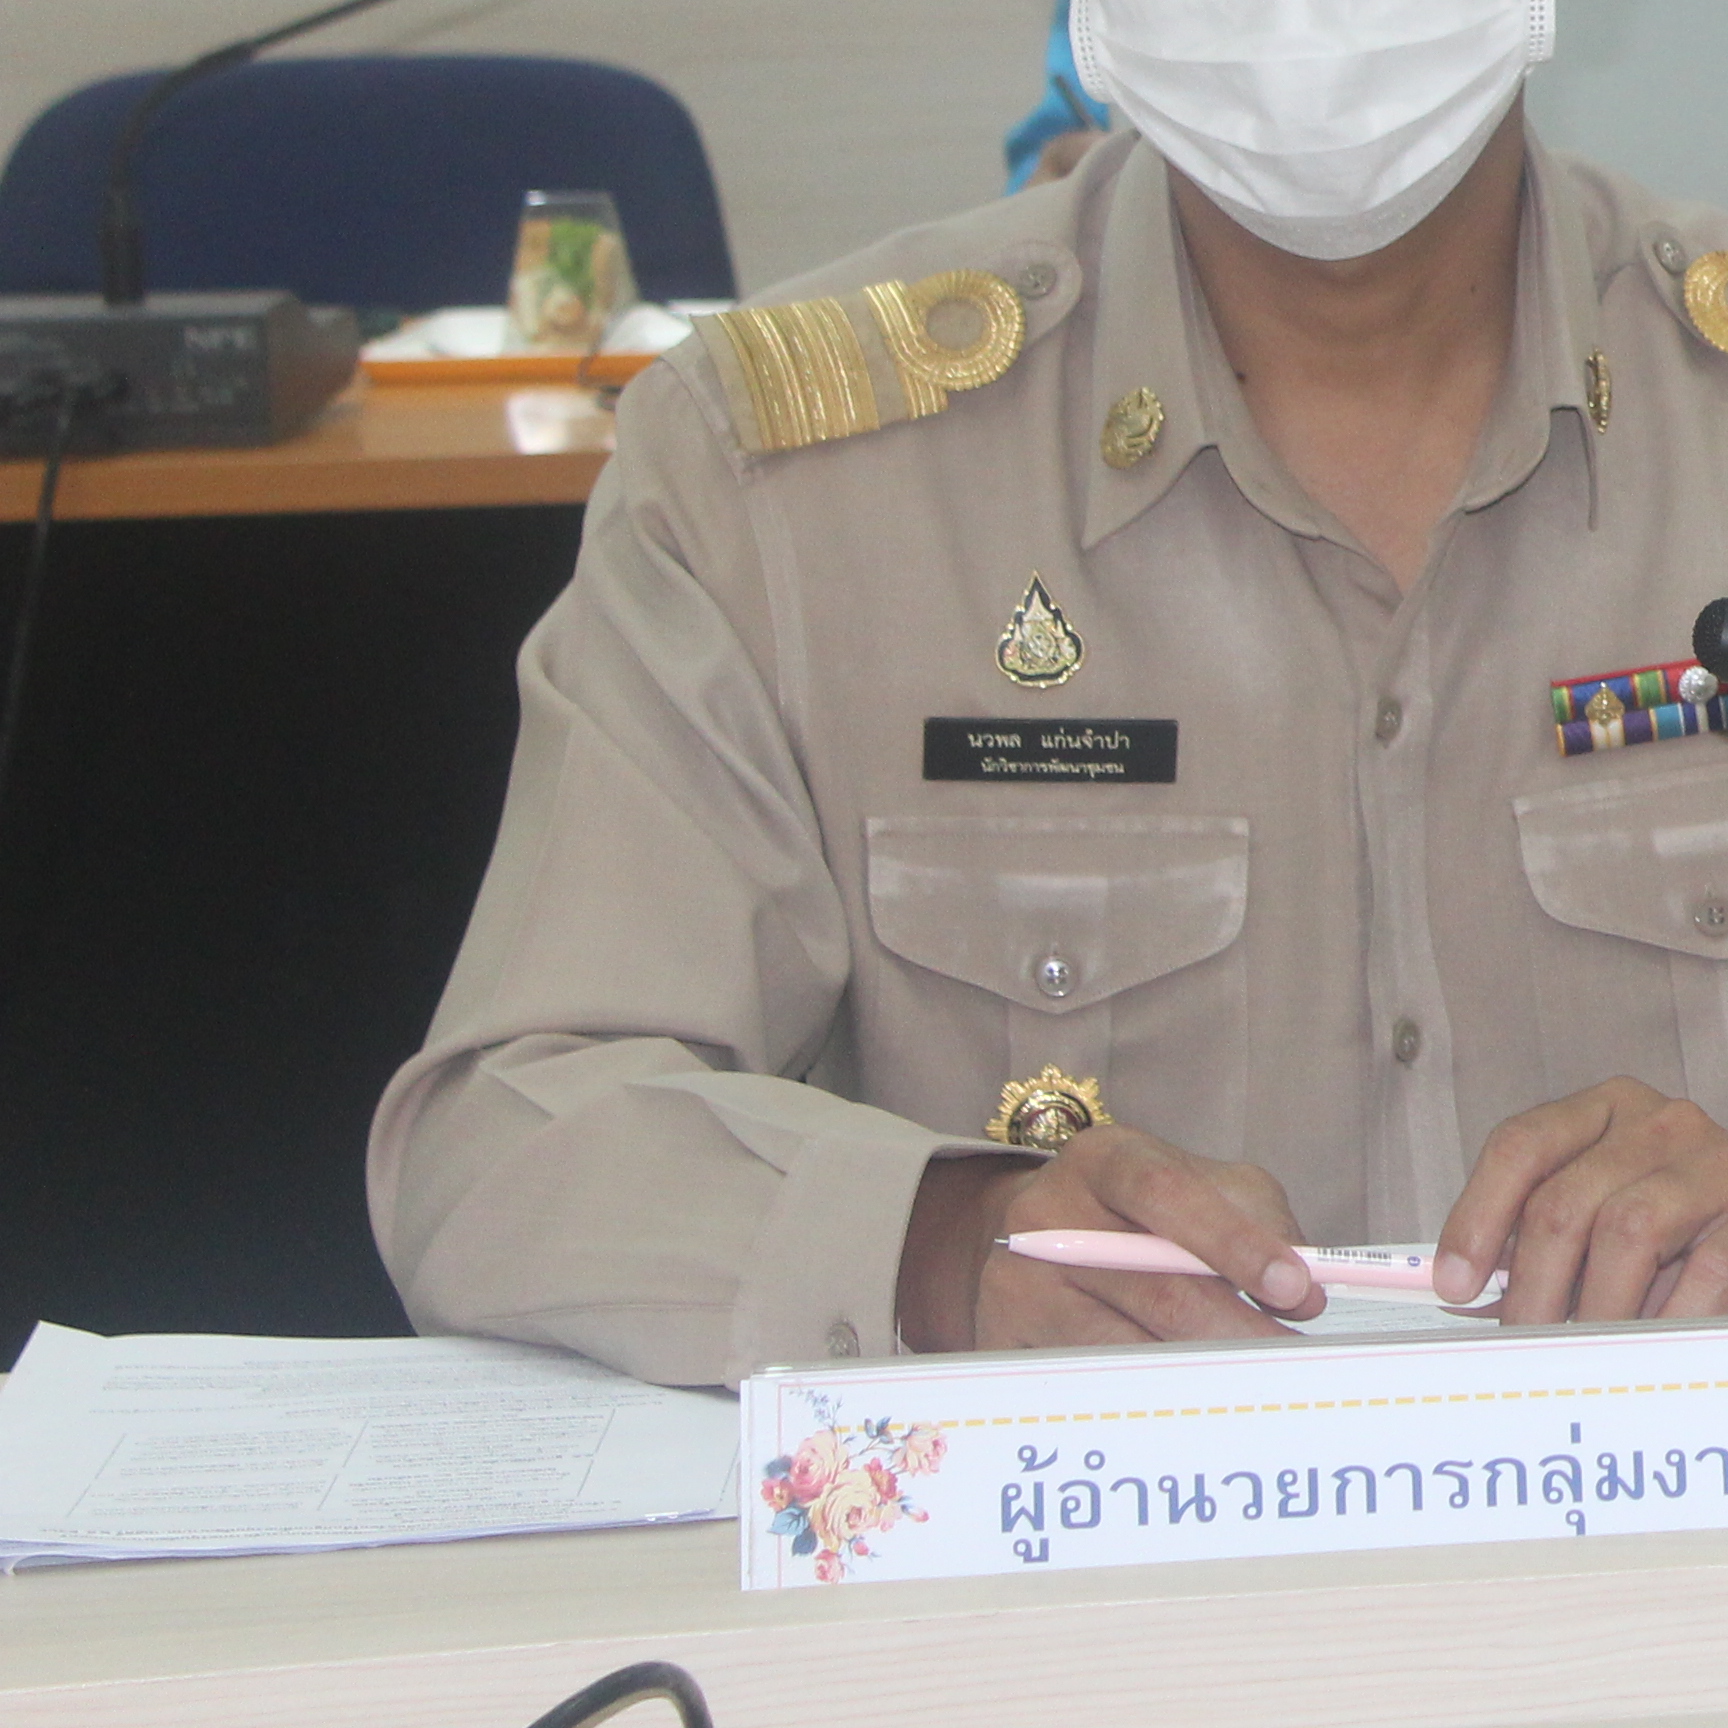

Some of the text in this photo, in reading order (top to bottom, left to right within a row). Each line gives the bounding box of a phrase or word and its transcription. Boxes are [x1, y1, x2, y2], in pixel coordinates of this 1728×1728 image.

[967, 727, 1130, 750] นวพล แก่นจำปา
